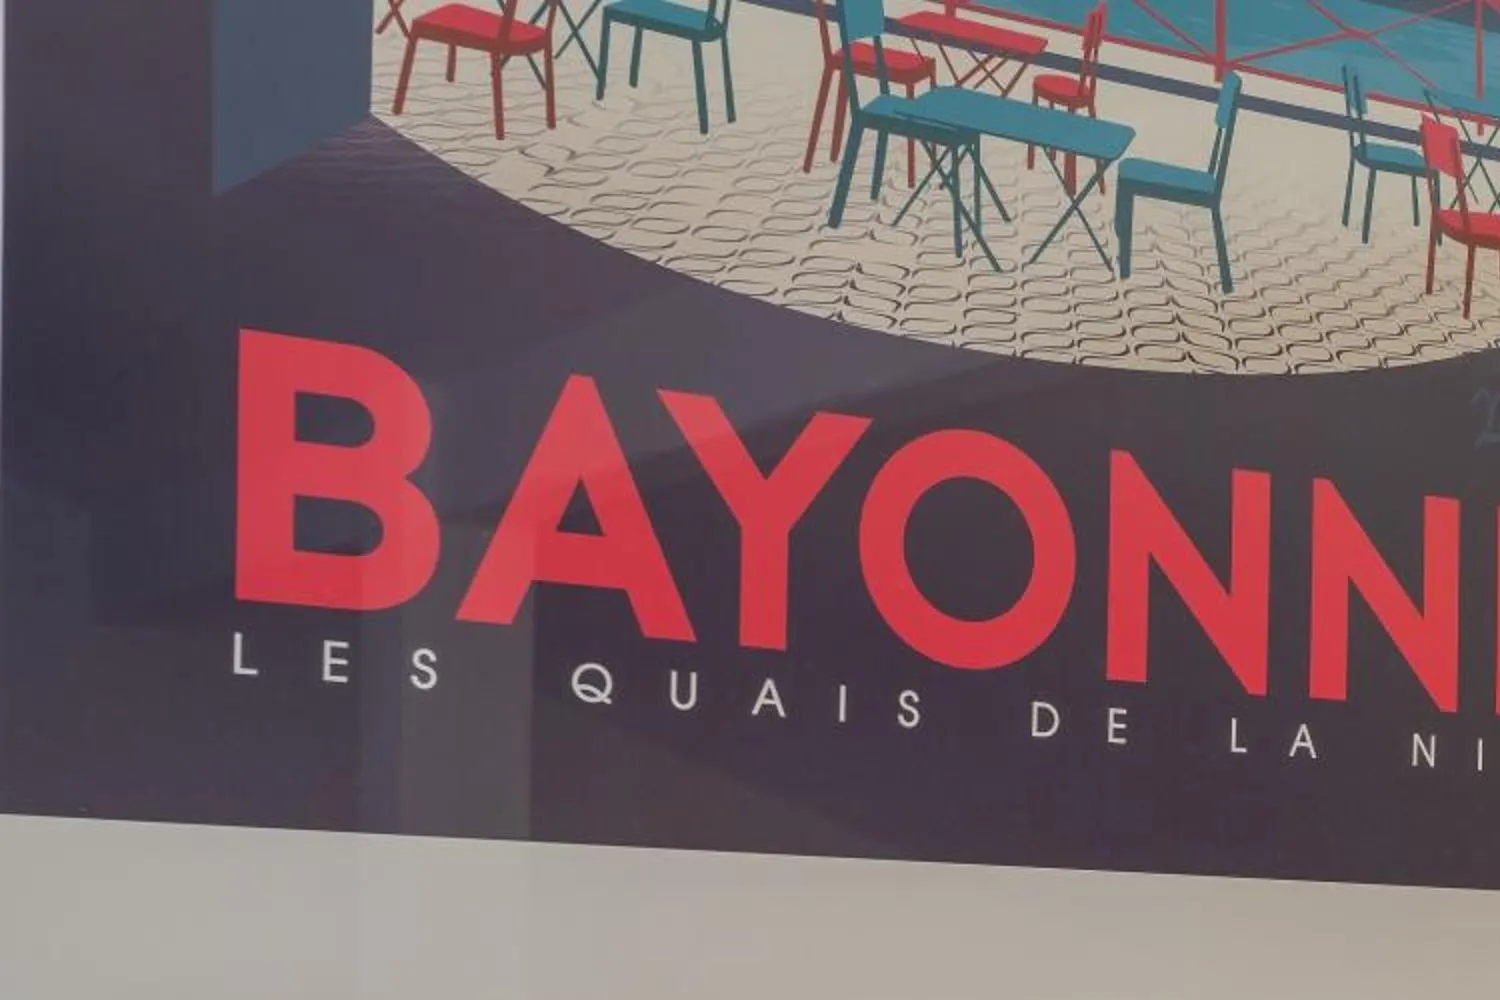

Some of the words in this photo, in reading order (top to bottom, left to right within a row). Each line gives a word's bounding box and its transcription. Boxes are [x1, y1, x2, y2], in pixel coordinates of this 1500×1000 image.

[232, 631, 438, 690] LES
[570, 662, 922, 729] QUAIS
[1030, 701, 1129, 745] DE
[1229, 718, 1318, 760] LA
